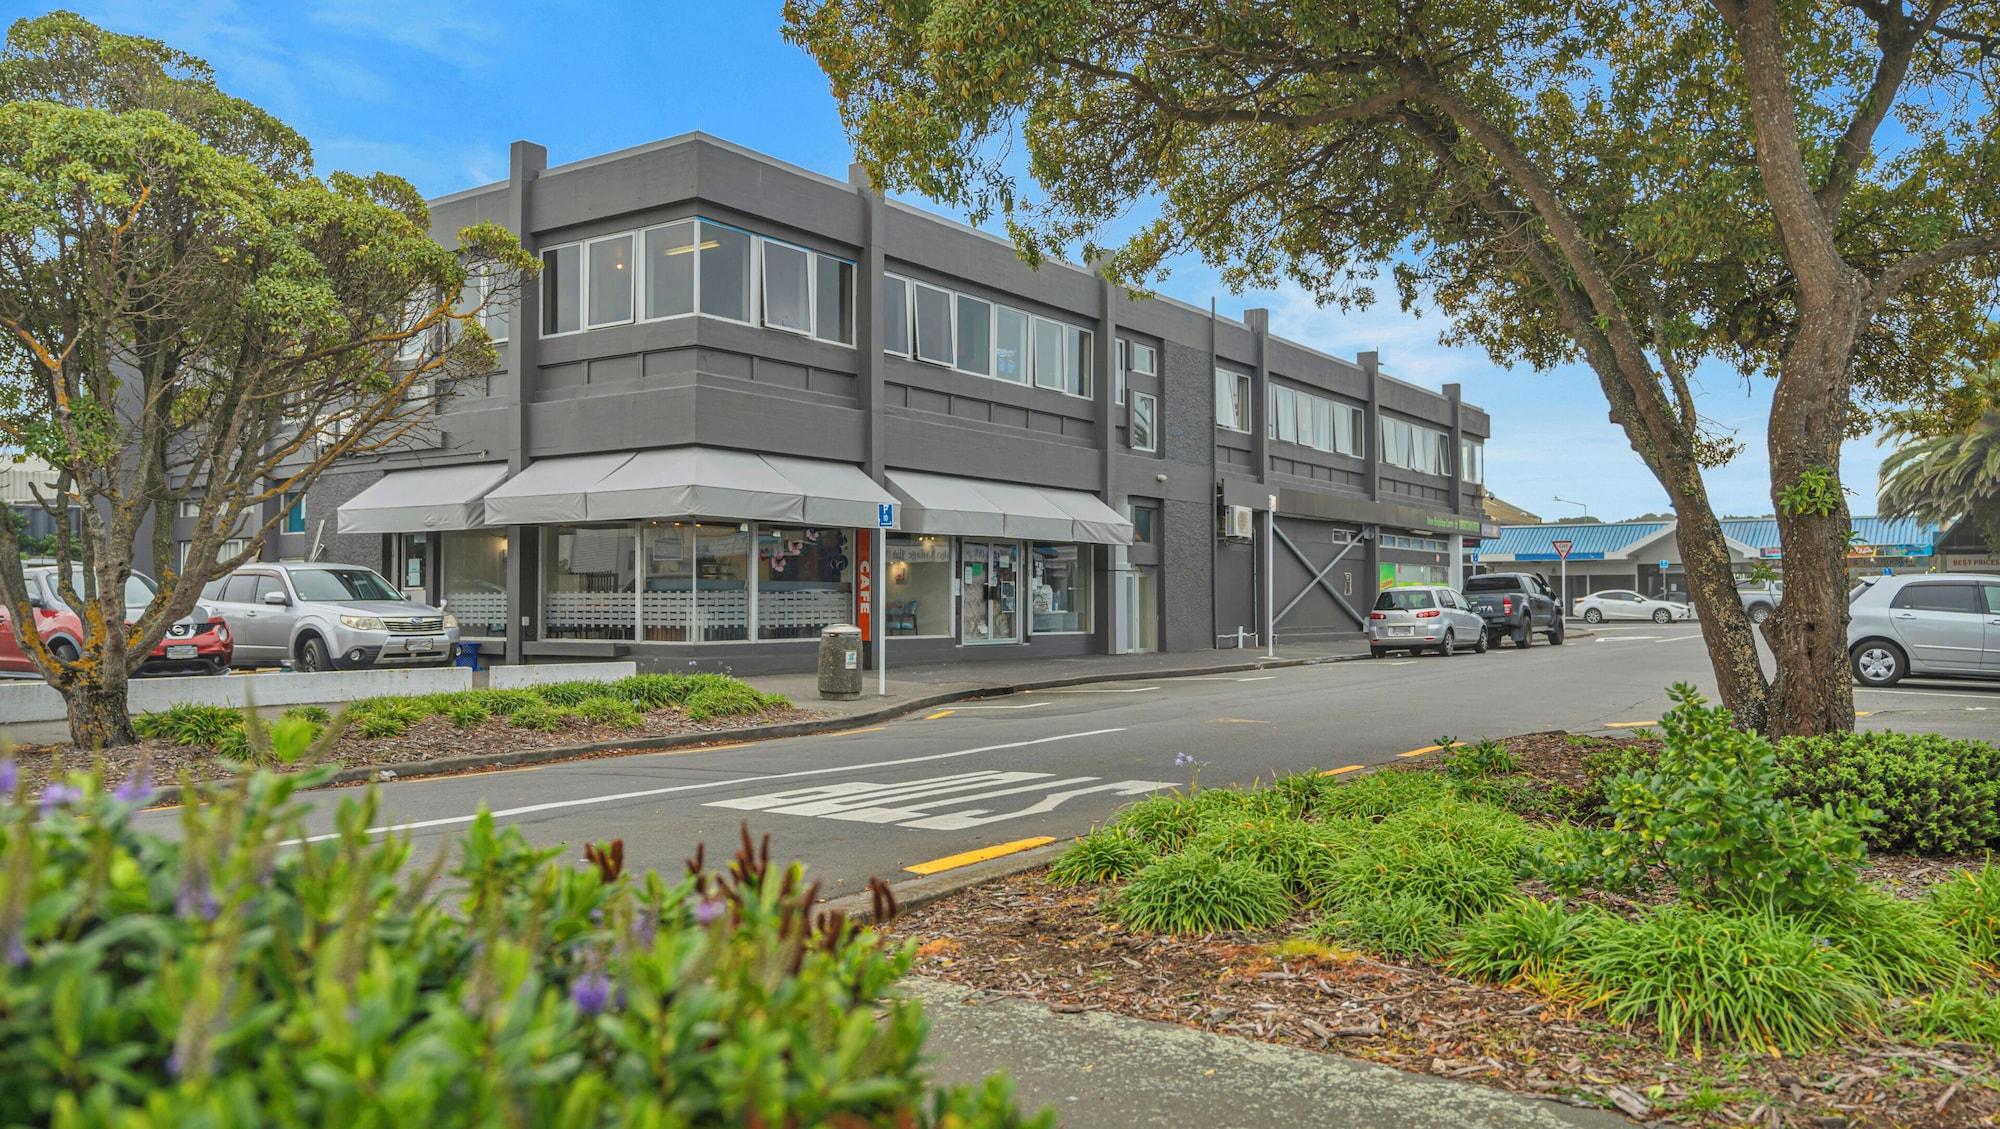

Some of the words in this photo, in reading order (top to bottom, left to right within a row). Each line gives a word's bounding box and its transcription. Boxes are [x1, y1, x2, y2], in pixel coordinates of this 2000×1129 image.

[882, 504, 889, 514] P
[860, 561, 870, 614] CAFE
[700, 770, 1182, 831] STOP
